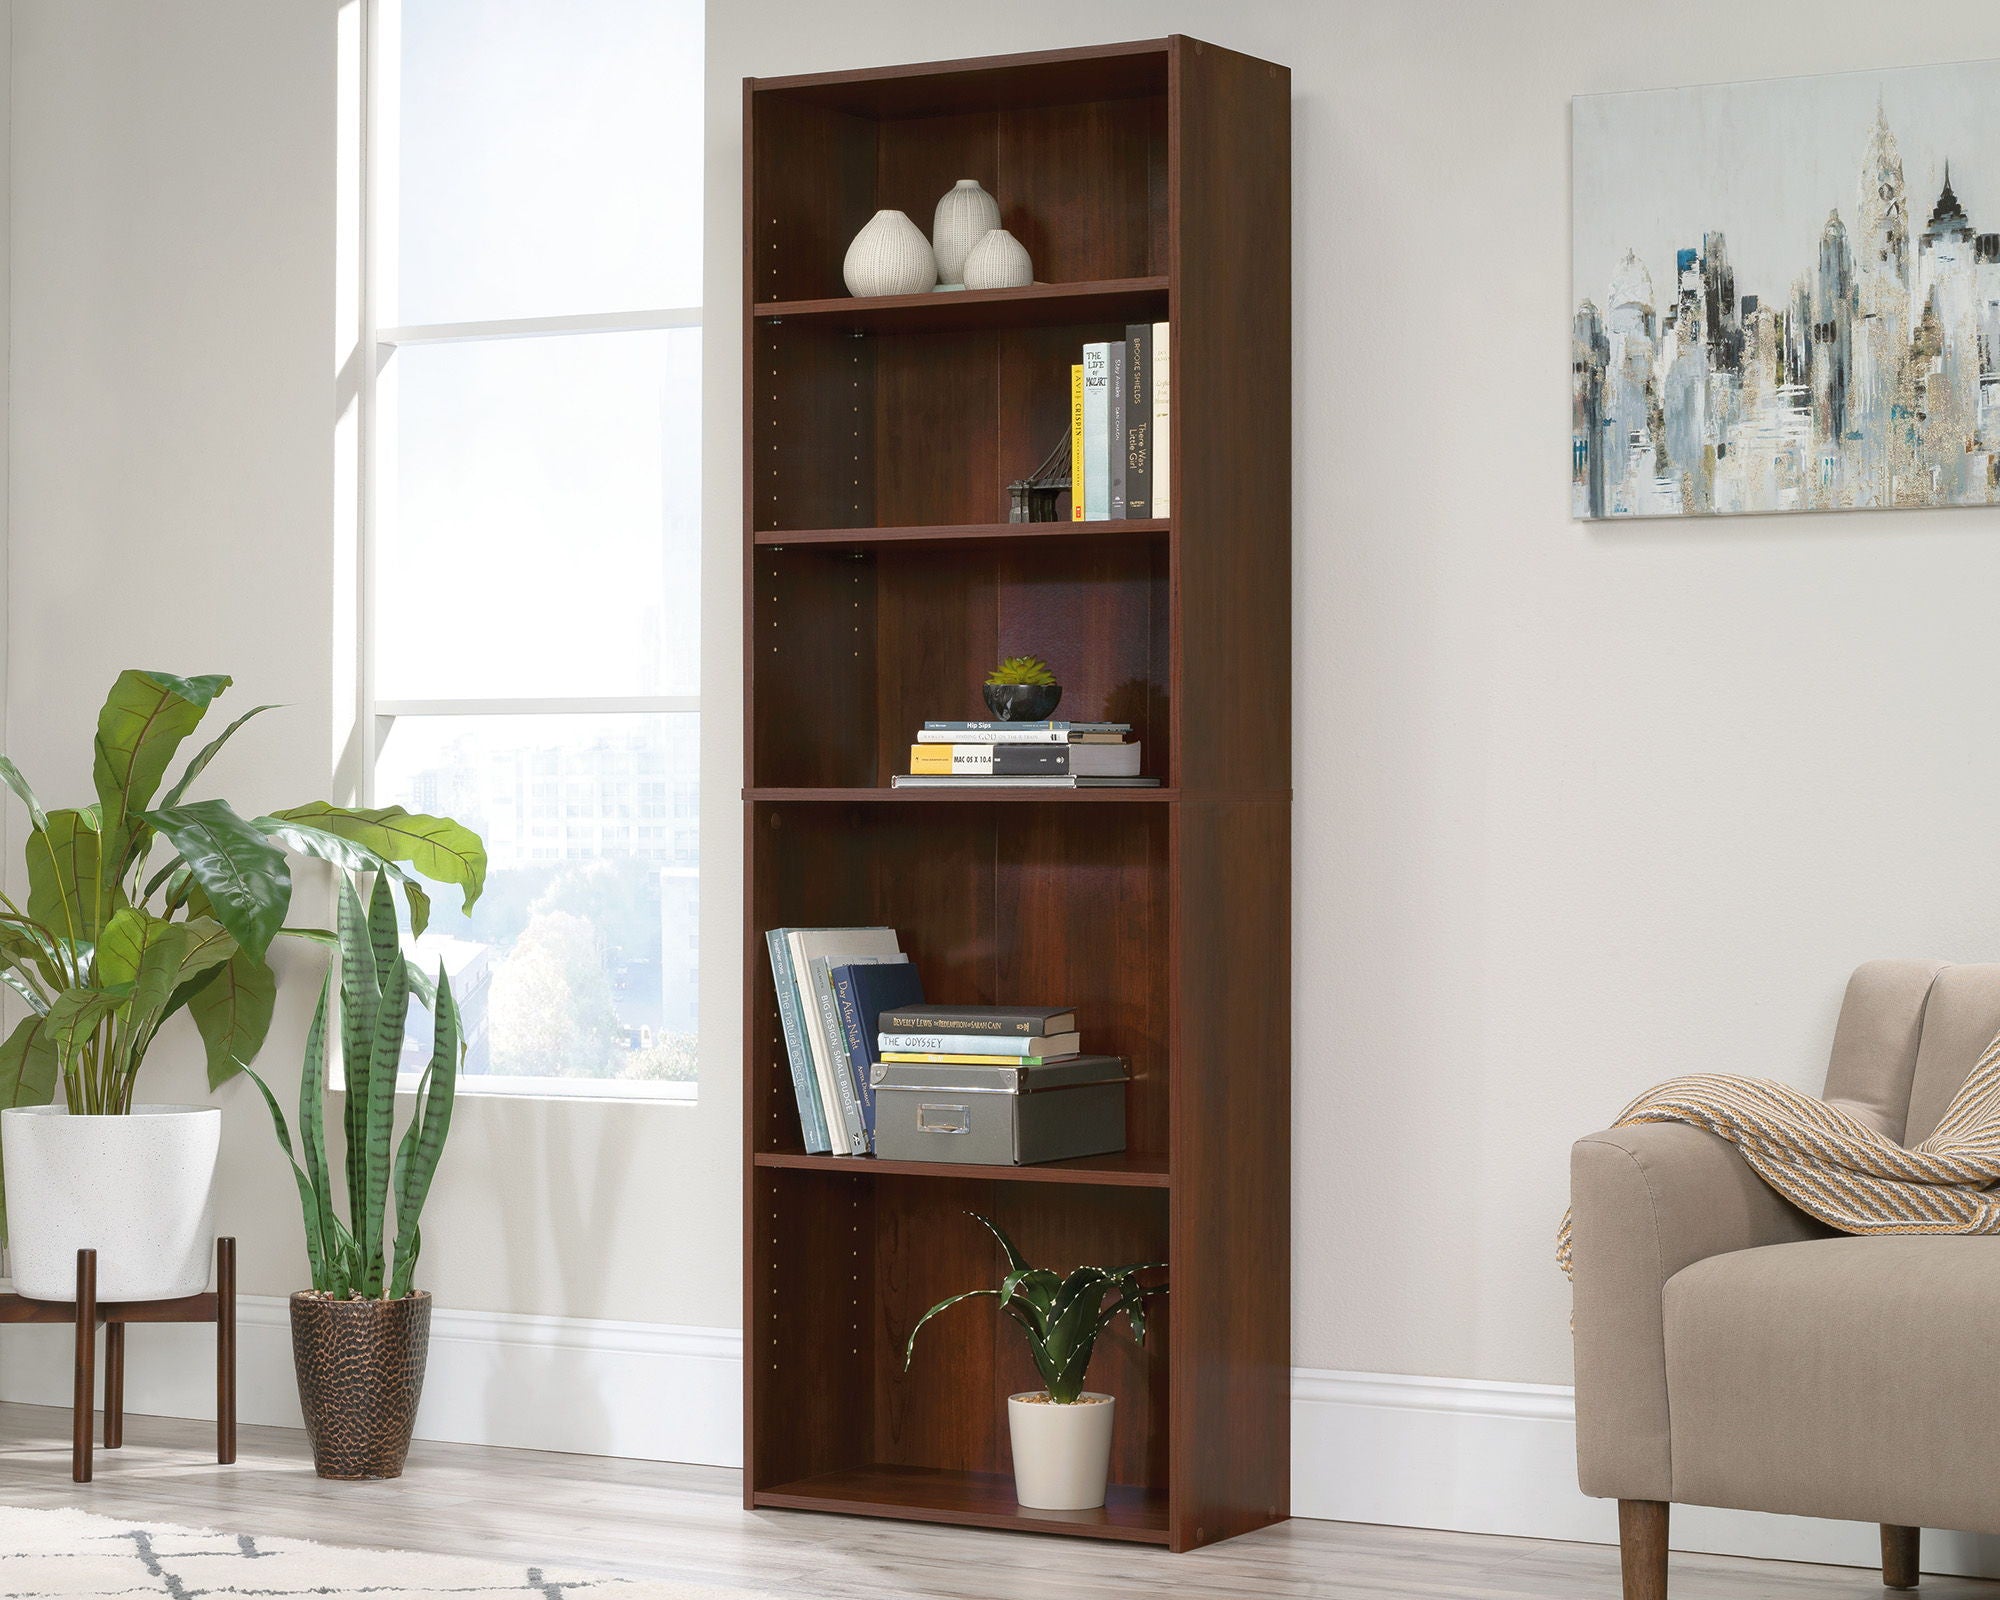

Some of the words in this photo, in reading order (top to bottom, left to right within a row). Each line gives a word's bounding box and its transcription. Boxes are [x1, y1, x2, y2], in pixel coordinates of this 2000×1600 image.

[1086, 352, 1102, 360] THE
[1088, 361, 1104, 369] LIFE
[1085, 377, 1108, 387] MOZART
[1129, 429, 1137, 451] Little
[1138, 423, 1147, 447] There
[1129, 452, 1138, 469] Girl
[1138, 449, 1146, 467] Was
[774, 939, 782, 961] heather
[838, 981, 848, 999] Day
[781, 992, 790, 1009] the
[842, 1000, 854, 1024] After
[784, 1012, 800, 1048] natural
[893, 1017, 916, 1027] BEVERLY
[916, 1018, 933, 1027] LEWIS
[987, 1021, 1002, 1030] CAIN
[848, 1023, 860, 1050] Night
[884, 1037, 899, 1046] THE
[905, 1037, 943, 1048] ODYSSEY
[821, 995, 831, 1011] BIG
[833, 1050, 846, 1079] SMALL
[840, 1080, 854, 1116] BUDGET
[791, 1050, 807, 1090] eclectic
